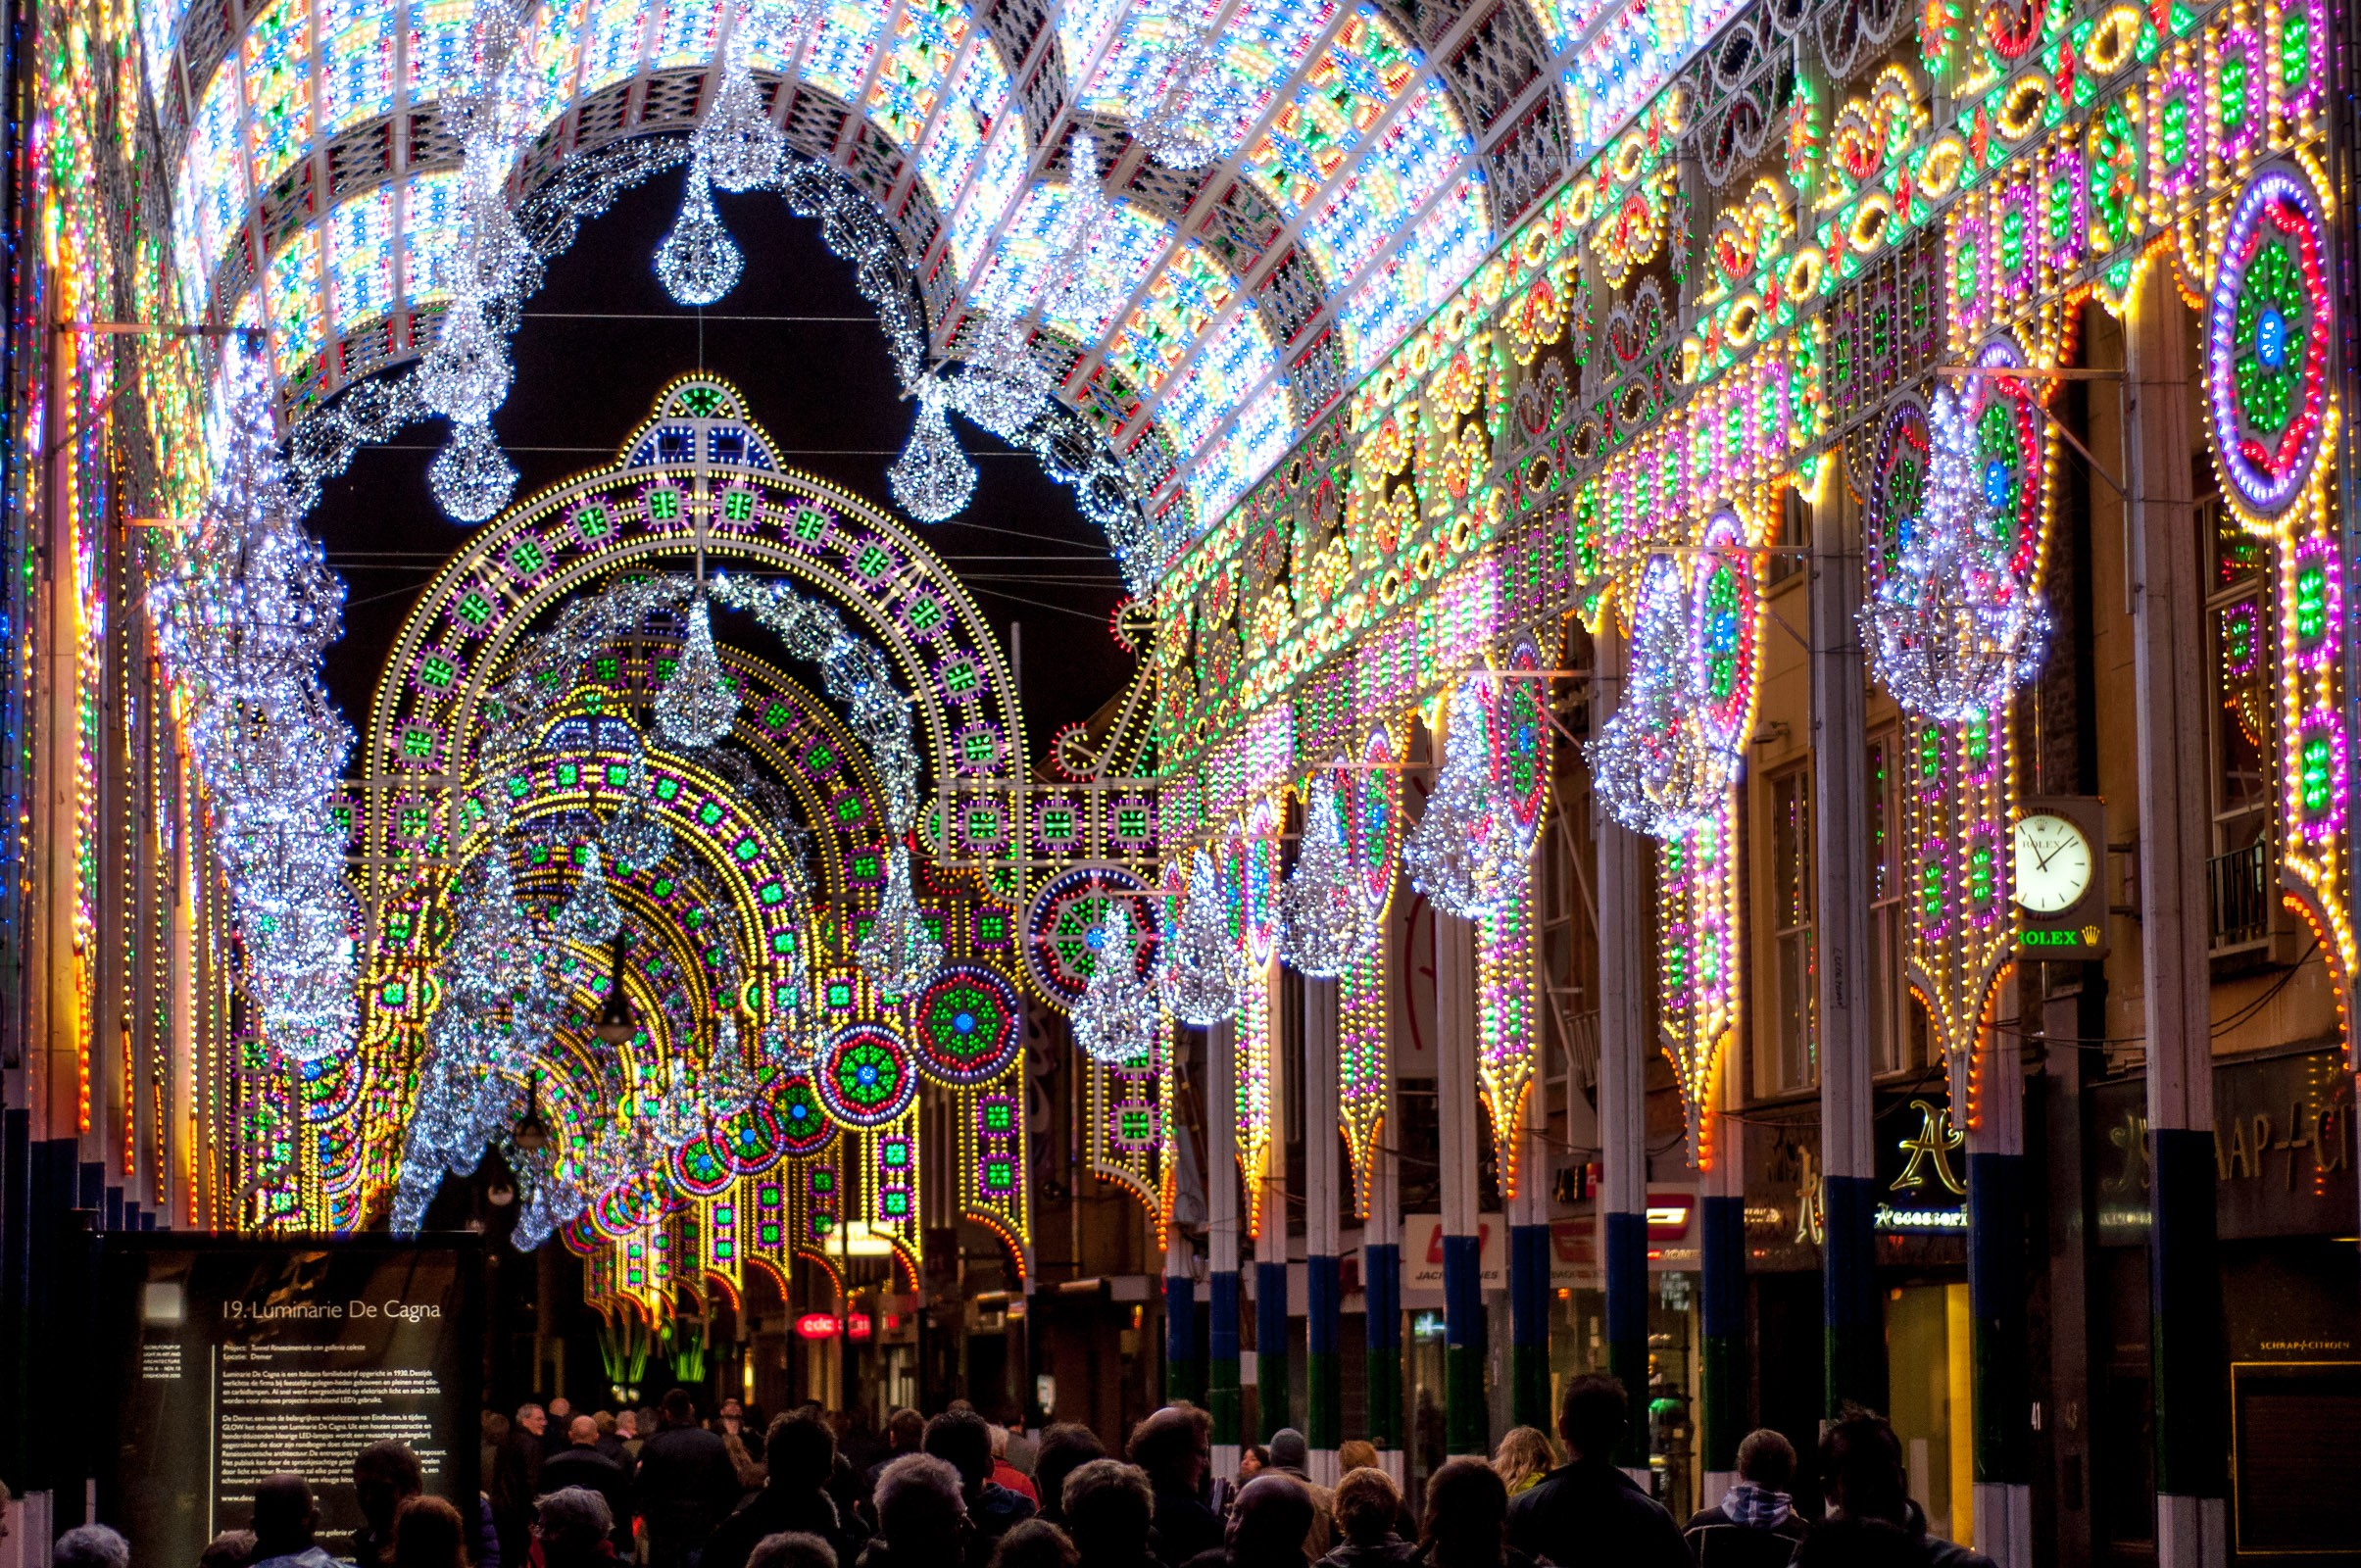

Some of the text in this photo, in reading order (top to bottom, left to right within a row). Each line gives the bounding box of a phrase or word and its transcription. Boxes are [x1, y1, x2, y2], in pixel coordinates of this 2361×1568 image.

[2022, 840, 2061, 850] ROLEX
[223, 1300, 442, 1323] 19. Luminarie De Cagna
[2031, 1402, 2041, 1431] 41
